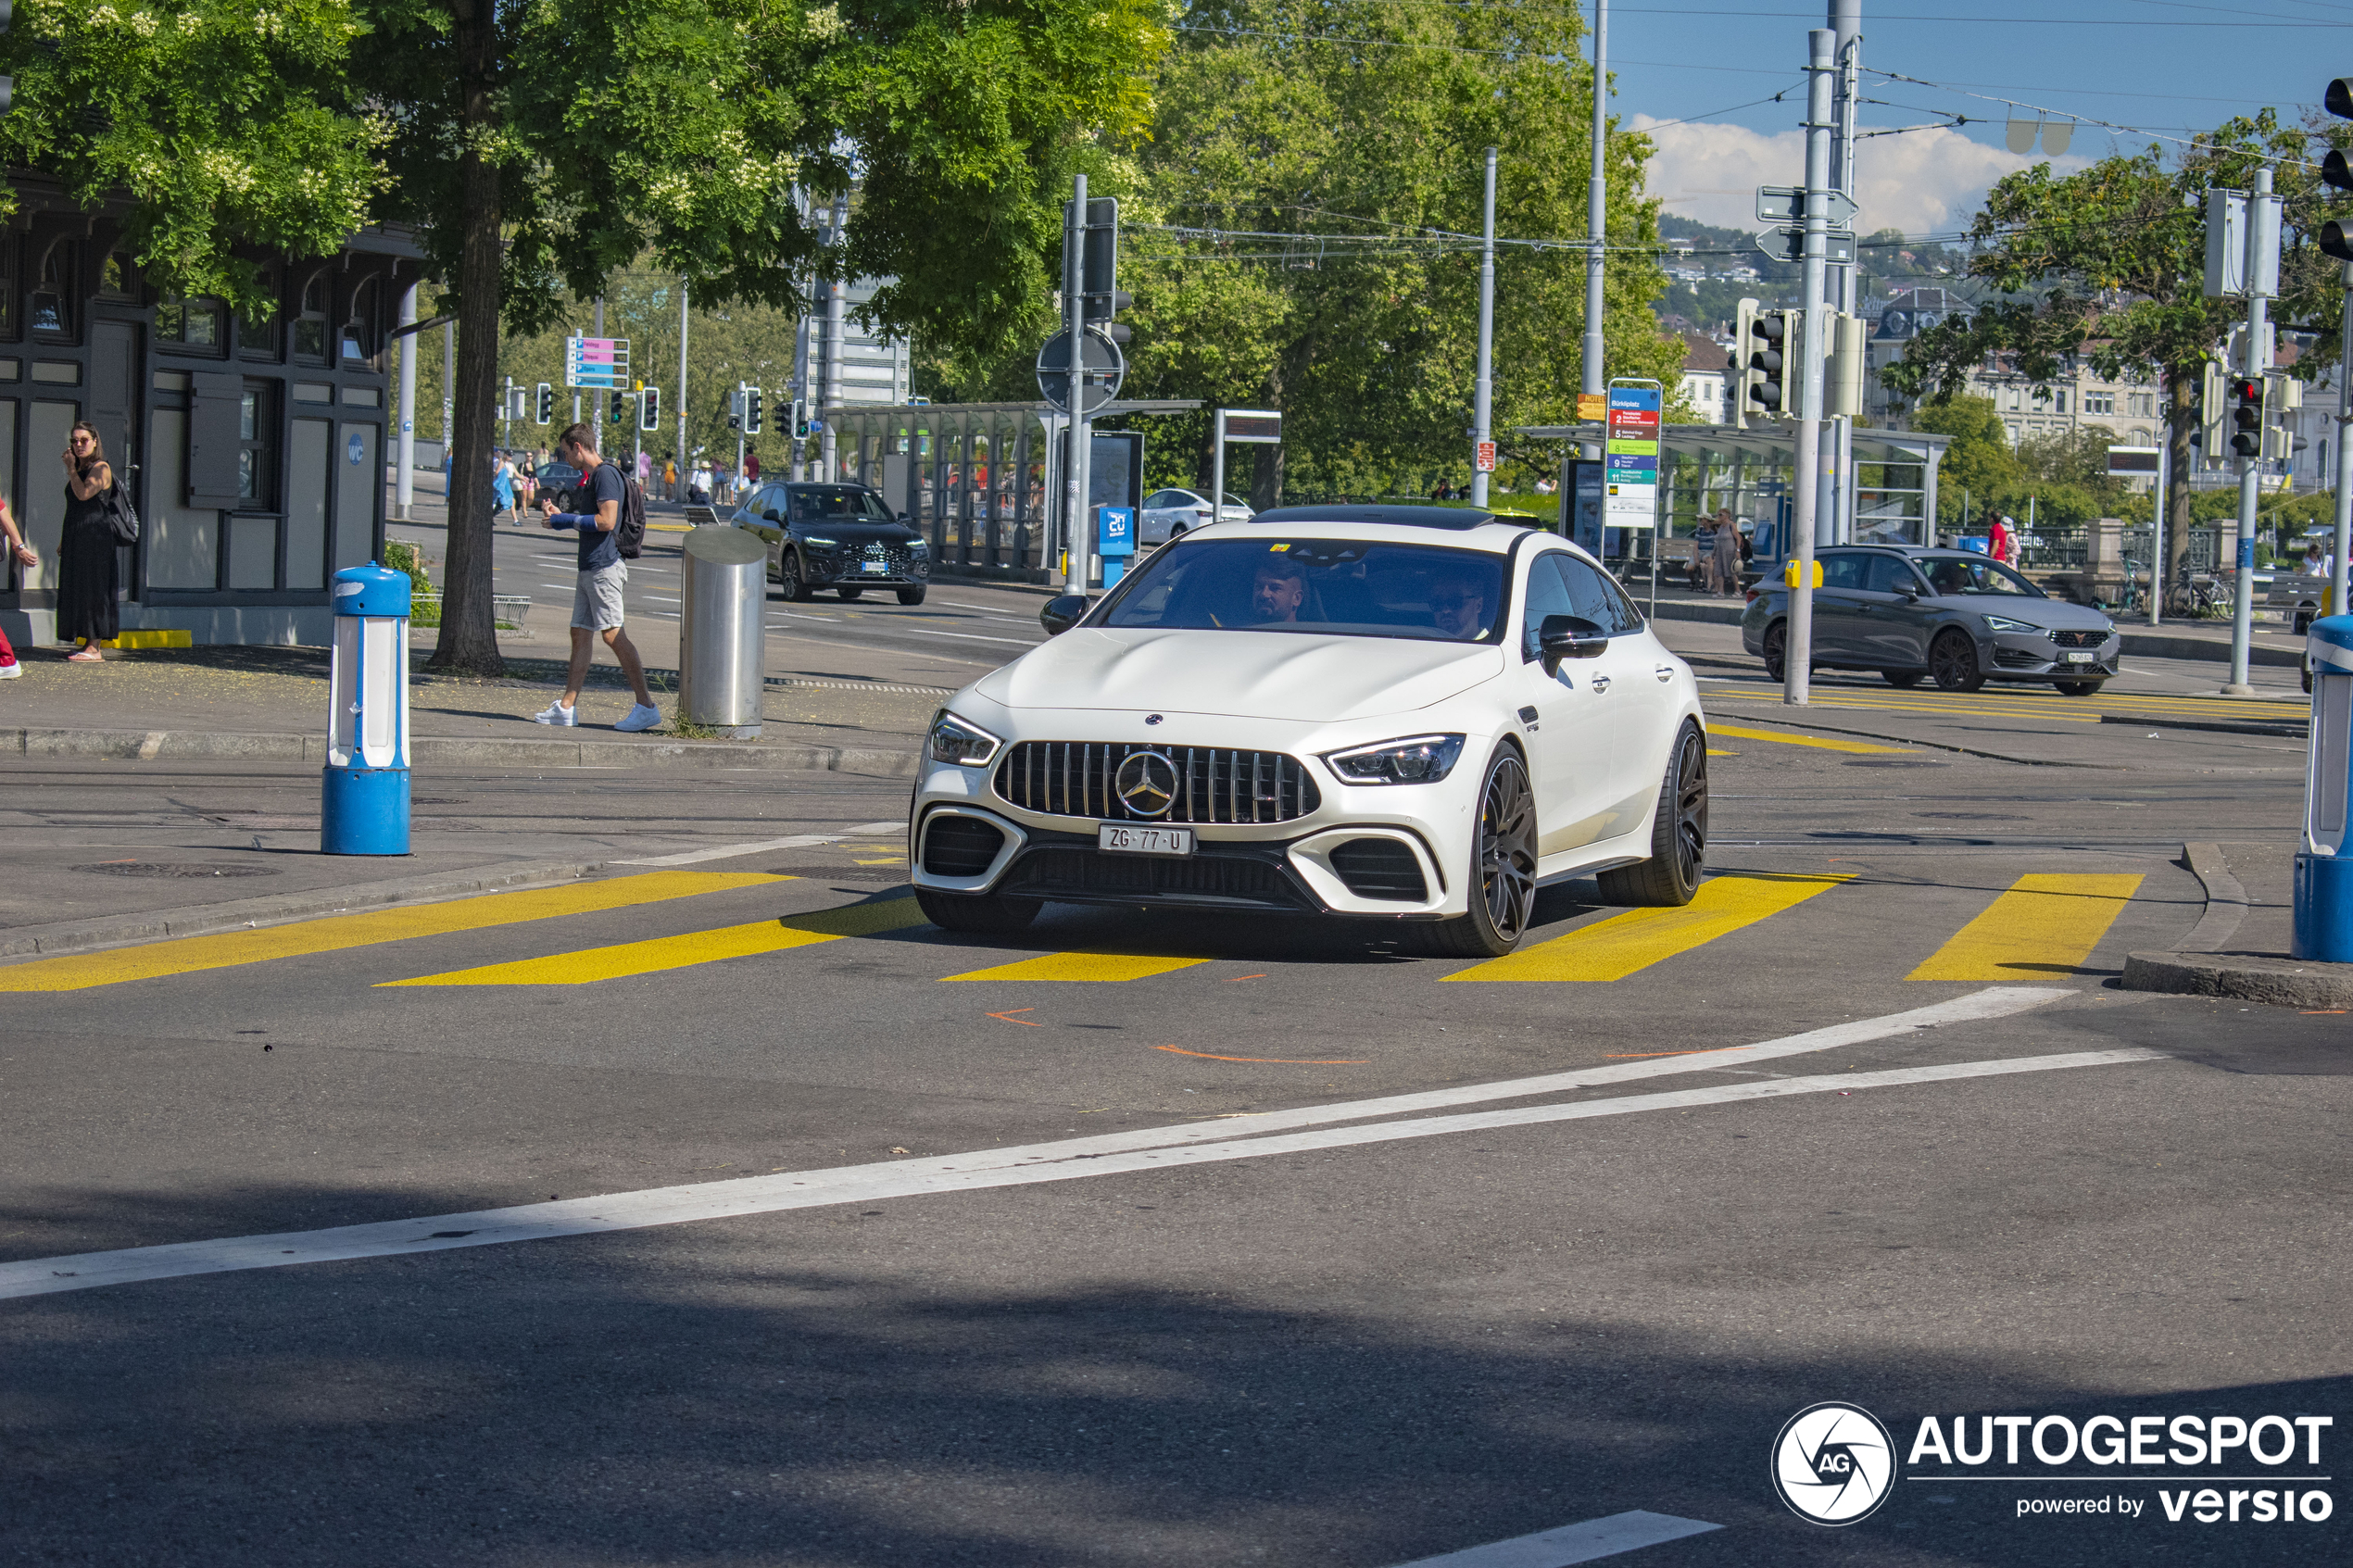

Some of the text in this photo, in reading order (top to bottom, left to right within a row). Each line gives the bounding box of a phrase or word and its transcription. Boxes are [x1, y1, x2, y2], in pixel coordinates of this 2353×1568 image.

[1616, 415, 1622, 423] 2
[1615, 430, 1621, 438] 5
[348, 445, 363, 461] WC
[1615, 445, 1620, 453] 8
[1614, 459, 1620, 468] 9
[1612, 473, 1619, 482] 11
[1109, 514, 1125, 533] 20
